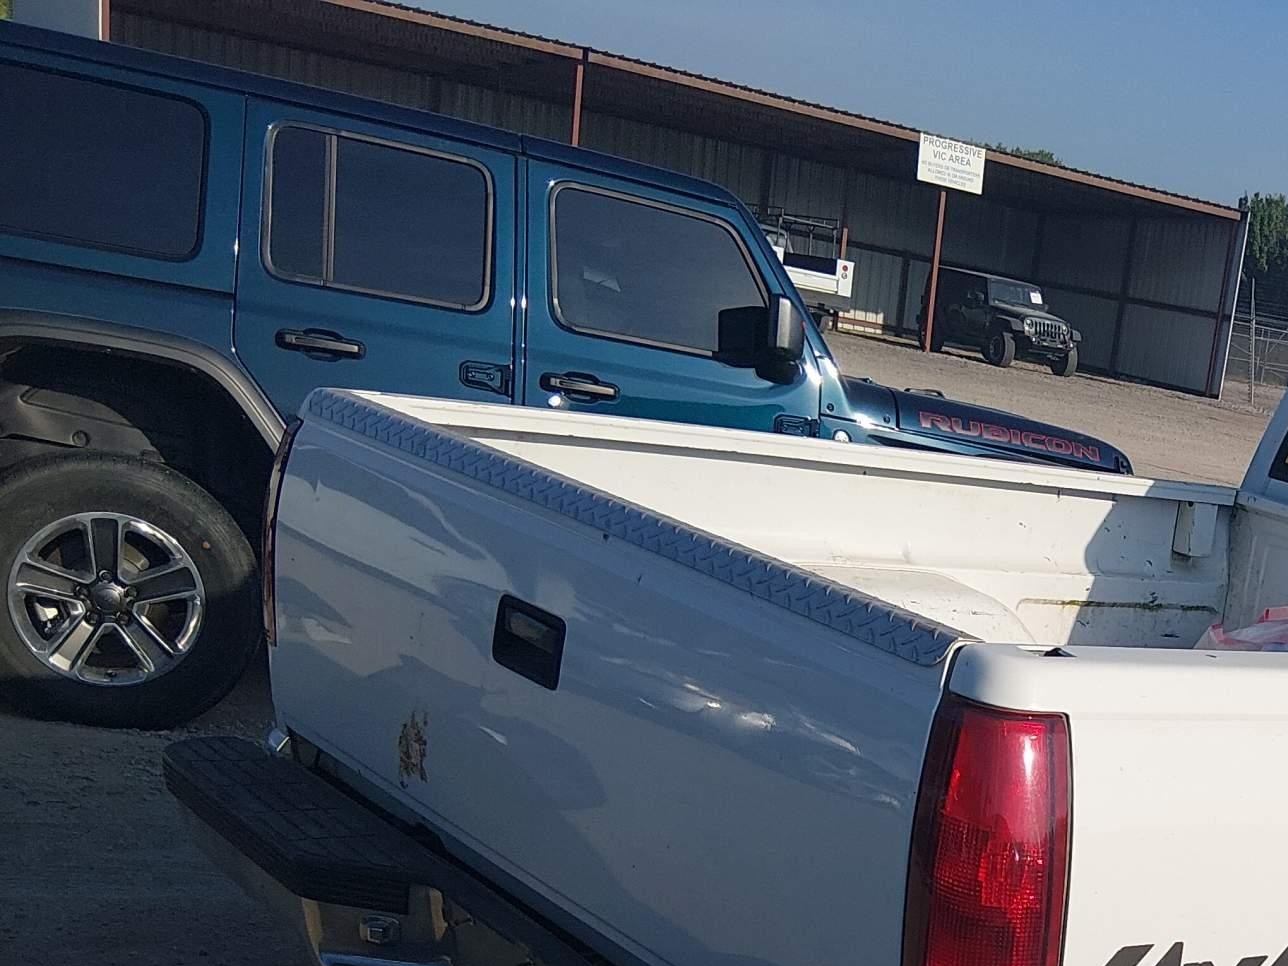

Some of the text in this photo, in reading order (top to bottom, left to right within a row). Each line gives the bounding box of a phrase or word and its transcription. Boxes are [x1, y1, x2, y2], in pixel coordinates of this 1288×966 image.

[923, 136, 982, 158] PROGRESSIVE
[933, 150, 971, 167] VIC AREA
[919, 411, 1100, 462] RUBICON
